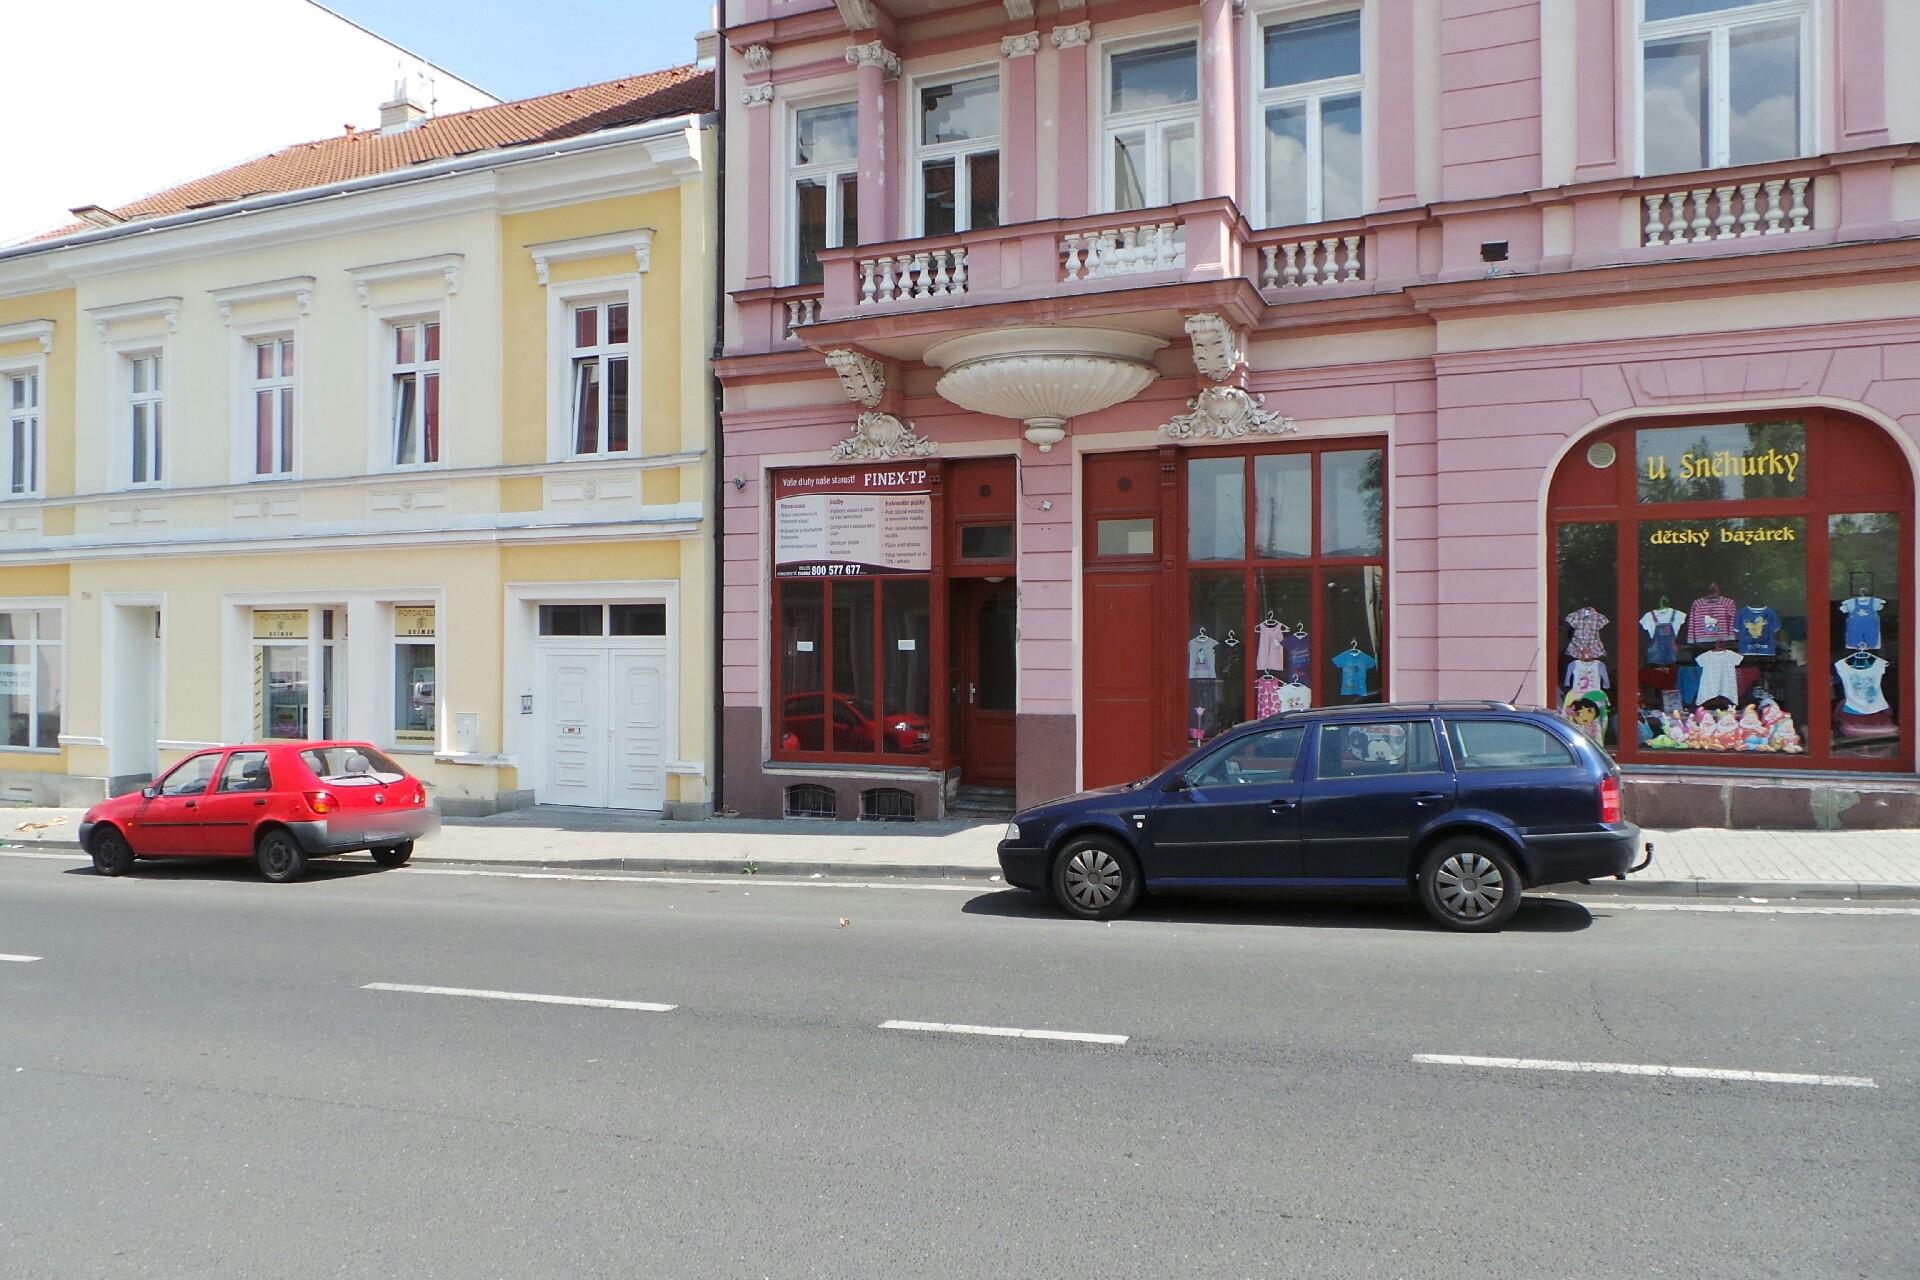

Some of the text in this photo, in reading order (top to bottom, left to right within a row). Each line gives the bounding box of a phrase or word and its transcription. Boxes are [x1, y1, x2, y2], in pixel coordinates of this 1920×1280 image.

[1648, 448, 1800, 482] U Sněhurky
[782, 477, 797, 487] Vaše
[798, 477, 814, 488] dluhy
[815, 475, 830, 486] naše
[864, 470, 927, 488] FINEX-TP
[1650, 526, 1796, 547] dětský bazárek
[811, 565, 826, 576] 800
[828, 565, 843, 575] 577
[845, 564, 860, 575] 677
